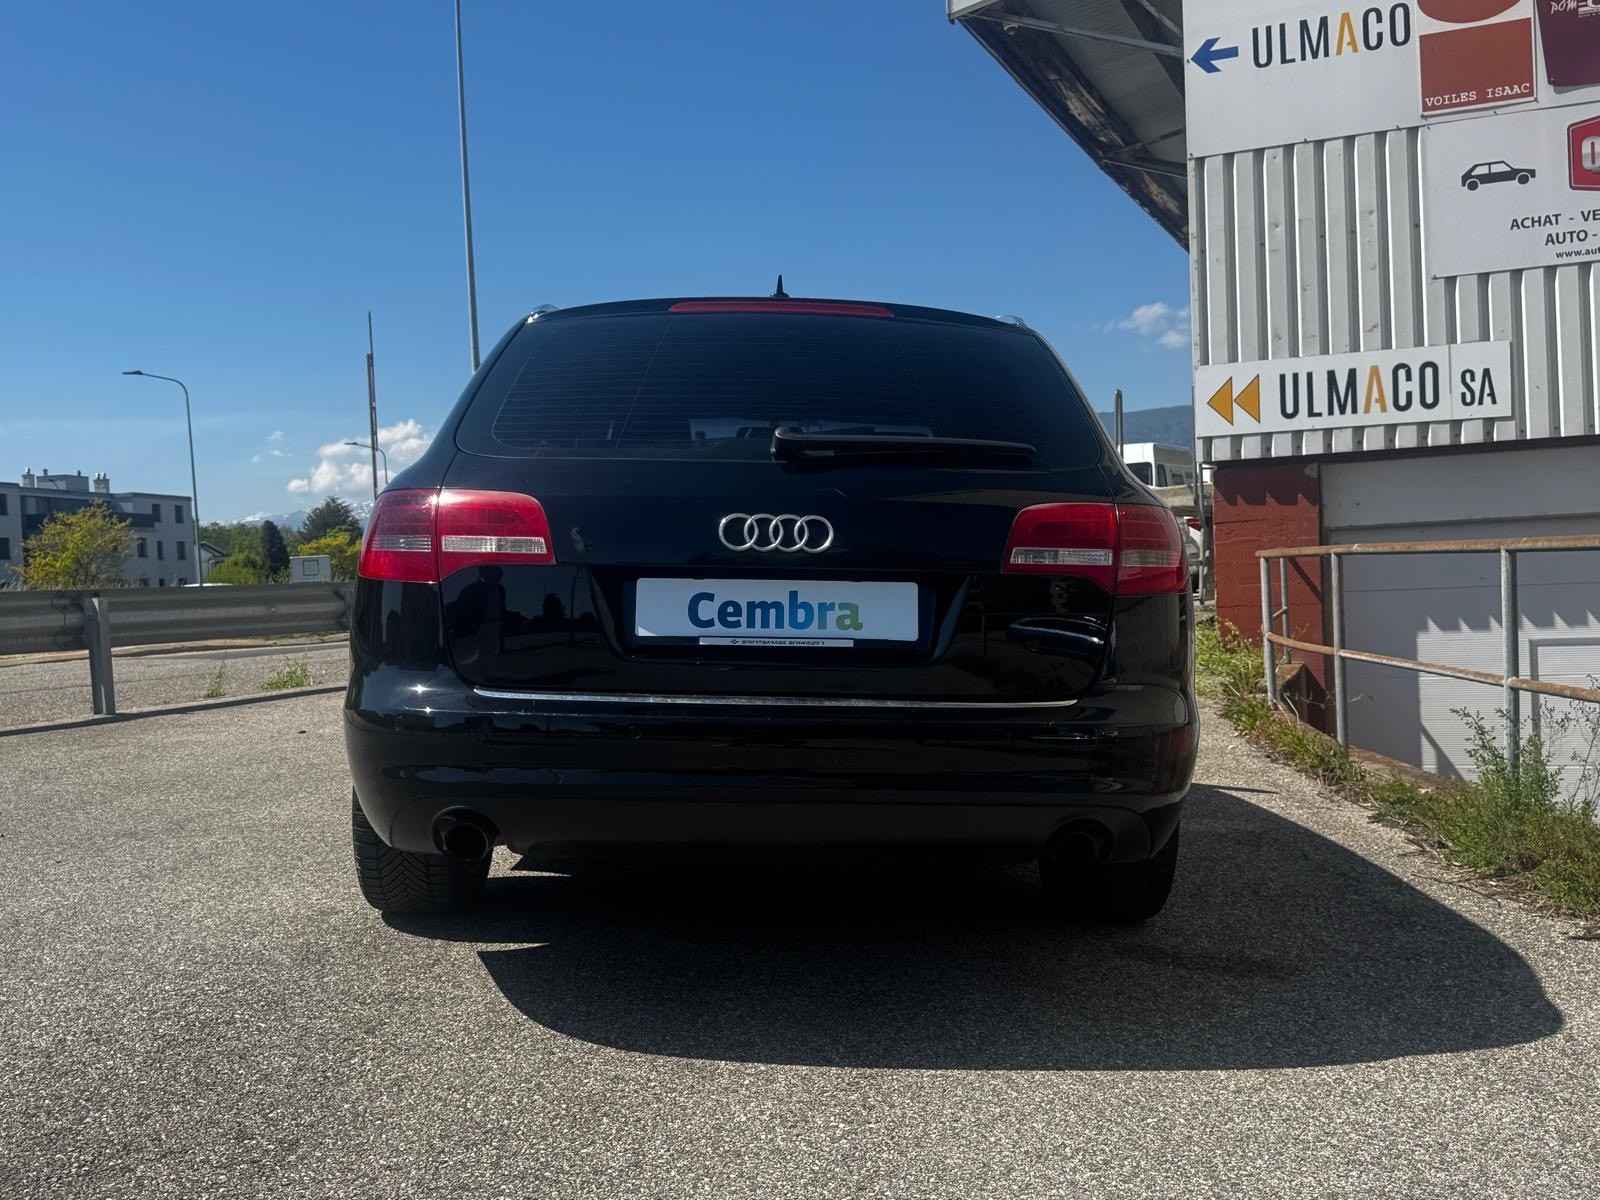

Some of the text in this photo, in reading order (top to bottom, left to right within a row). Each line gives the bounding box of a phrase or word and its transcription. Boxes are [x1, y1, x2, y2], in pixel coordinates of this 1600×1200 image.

[1251, 4, 1411, 69] ULMACO
[1424, 82, 1531, 107] VOILES ISAAC
[1510, 213, 1562, 230] ACHAT
[1545, 229, 1588, 246] AUTO
[1278, 360, 1498, 420] ULMACO SA
[687, 590, 864, 631] Cembra
